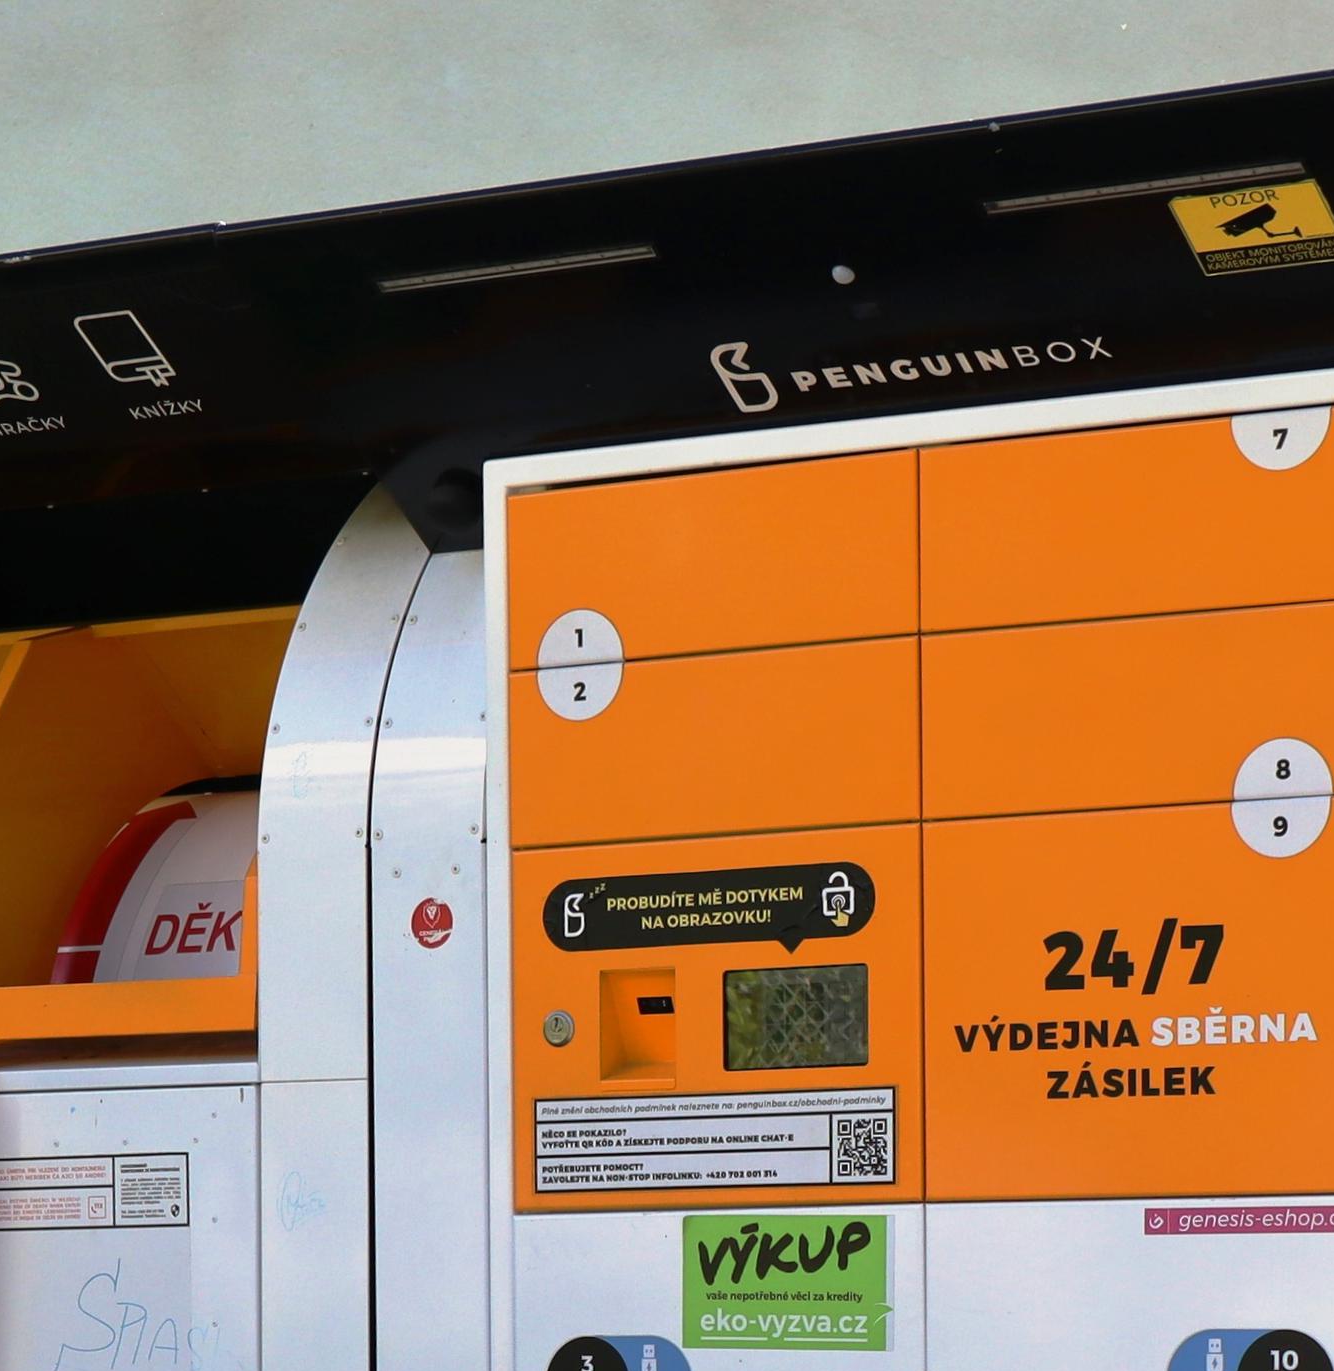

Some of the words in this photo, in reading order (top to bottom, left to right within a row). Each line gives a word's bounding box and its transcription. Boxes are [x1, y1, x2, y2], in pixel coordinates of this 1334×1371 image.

[1209, 189, 1279, 208] POZOR
[1205, 250, 1246, 263] OBJEKT
[1206, 256, 1281, 271] KAMEROVÝM
[790, 336, 1113, 392] PENGUINBOX
[128, 398, 203, 420] KNÍŽKY
[1272, 428, 1291, 450] 7
[575, 628, 583, 648] 1
[573, 682, 587, 701] 2
[1275, 759, 1292, 780] 8
[1272, 815, 1289, 837] 9
[606, 890, 695, 912] PROBUDÍTE
[698, 889, 722, 907] MĚ
[725, 885, 804, 905] DOTYKEM
[640, 914, 664, 930] NA
[666, 909, 772, 928] OBRAZOVKU!
[1042, 918, 1225, 995] 24/7
[954, 1015, 1140, 1053] VÝDEJNA
[1150, 1006, 1318, 1047] SBĚRNA
[1046, 1061, 1216, 1100] ZÁSILEK
[542, 1129, 565, 1139] NĚCO
[567, 1129, 578, 1138] SE
[579, 1128, 627, 1138] POKAZILO?
[581, 1140, 594, 1149] QR
[595, 1138, 614, 1148] KÓD
[615, 1139, 622, 1147] A
[624, 1137, 665, 1147] ZÍSKEJTE
[666, 1136, 708, 1146] PODPORU
[710, 1136, 724, 1144] NA
[725, 1134, 759, 1144] ONLINE
[542, 1163, 601, 1174] POTŘEBUJETE
[603, 1163, 644, 1172] POMOCT?
[542, 1175, 590, 1184] ZAVOLEJTE
[592, 1174, 605, 1183] NA
[698, 1220, 872, 1286] VÝKUP
[705, 1290, 728, 1302] vaše
[729, 1288, 790, 1304] nepotřebné
[791, 1289, 812, 1302] věci
[812, 1292, 825, 1302] za
[826, 1290, 863, 1305] kredity
[700, 1307, 868, 1339] eko-vyzva.cz
[1270, 1350, 1299, 1371] 10
